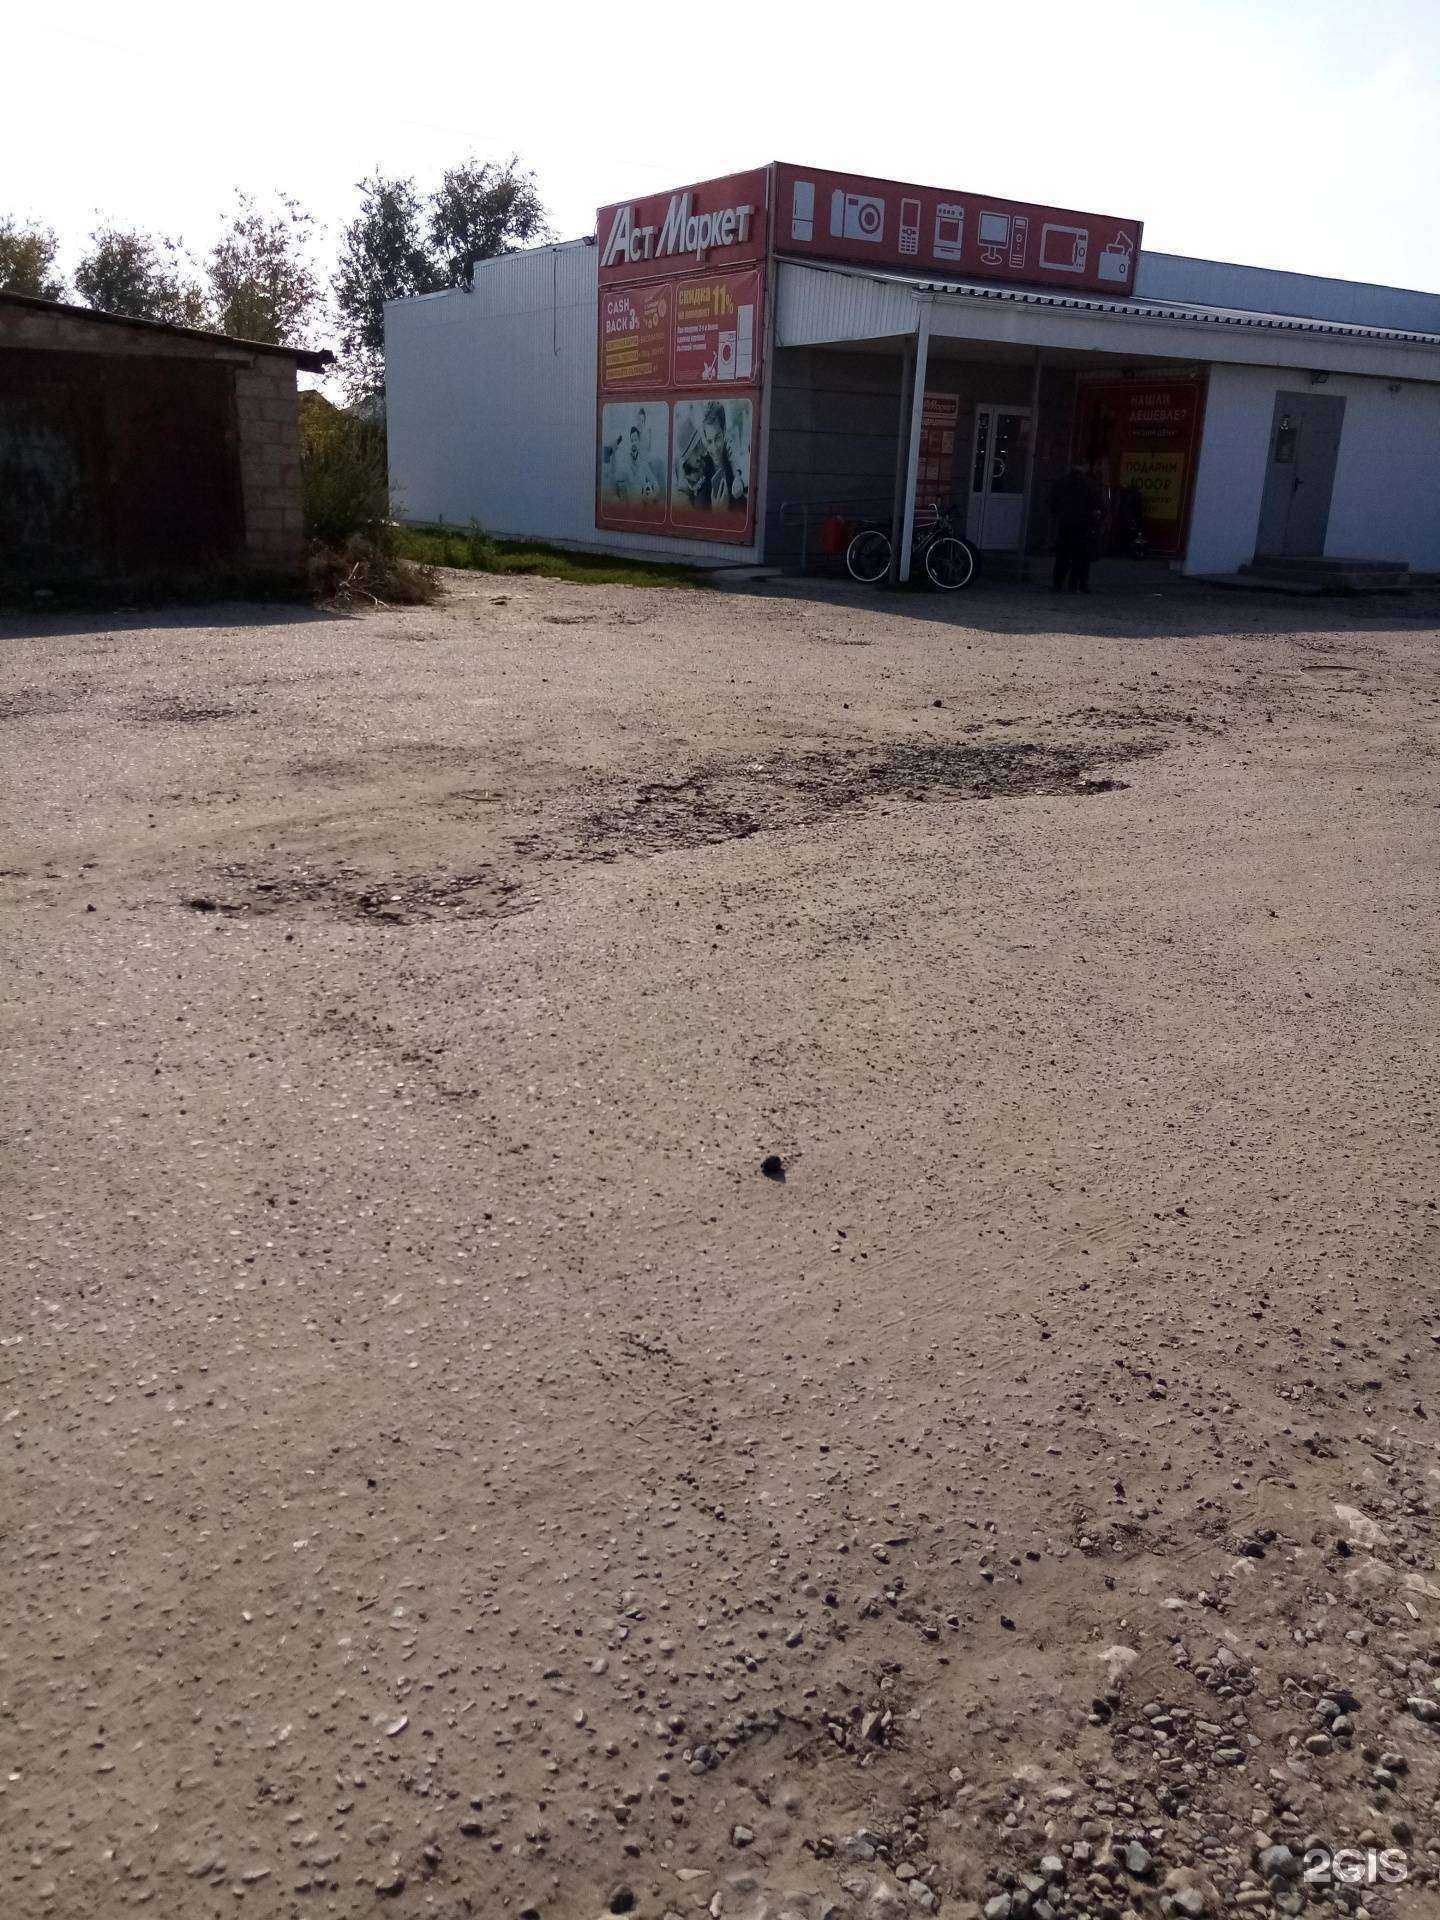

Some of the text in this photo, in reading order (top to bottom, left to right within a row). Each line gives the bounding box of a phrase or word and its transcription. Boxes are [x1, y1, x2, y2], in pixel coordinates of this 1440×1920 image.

[600, 192, 755, 267] Аст Маркет
[607, 298, 630, 314] CASH
[606, 317, 628, 333] BACK
